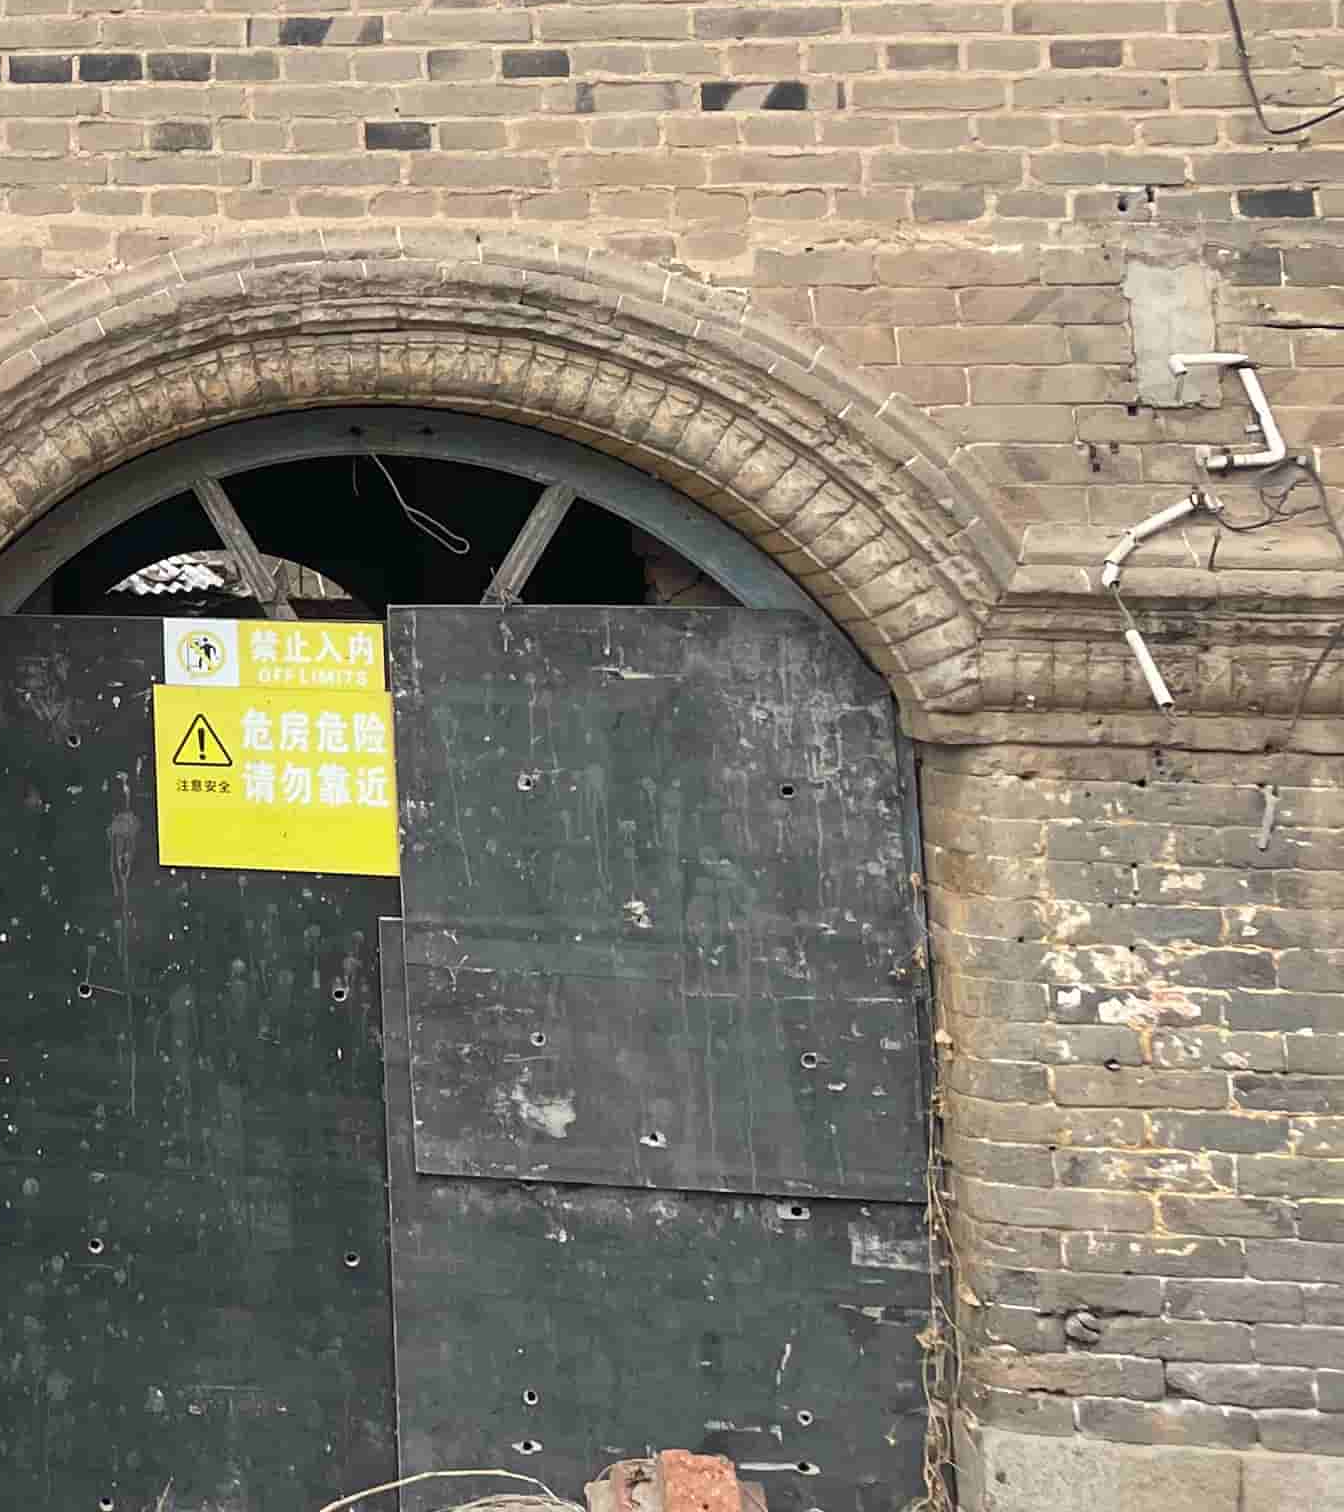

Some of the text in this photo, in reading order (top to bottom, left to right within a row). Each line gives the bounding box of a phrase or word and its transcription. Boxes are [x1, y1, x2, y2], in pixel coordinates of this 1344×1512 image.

[250, 629, 374, 665] 禁止入内
[258, 668, 369, 687] OFF LIMITS
[241, 708, 386, 754] 危房危险
[176, 778, 231, 794] 注意安全
[242, 760, 390, 808] 请勿靠近
